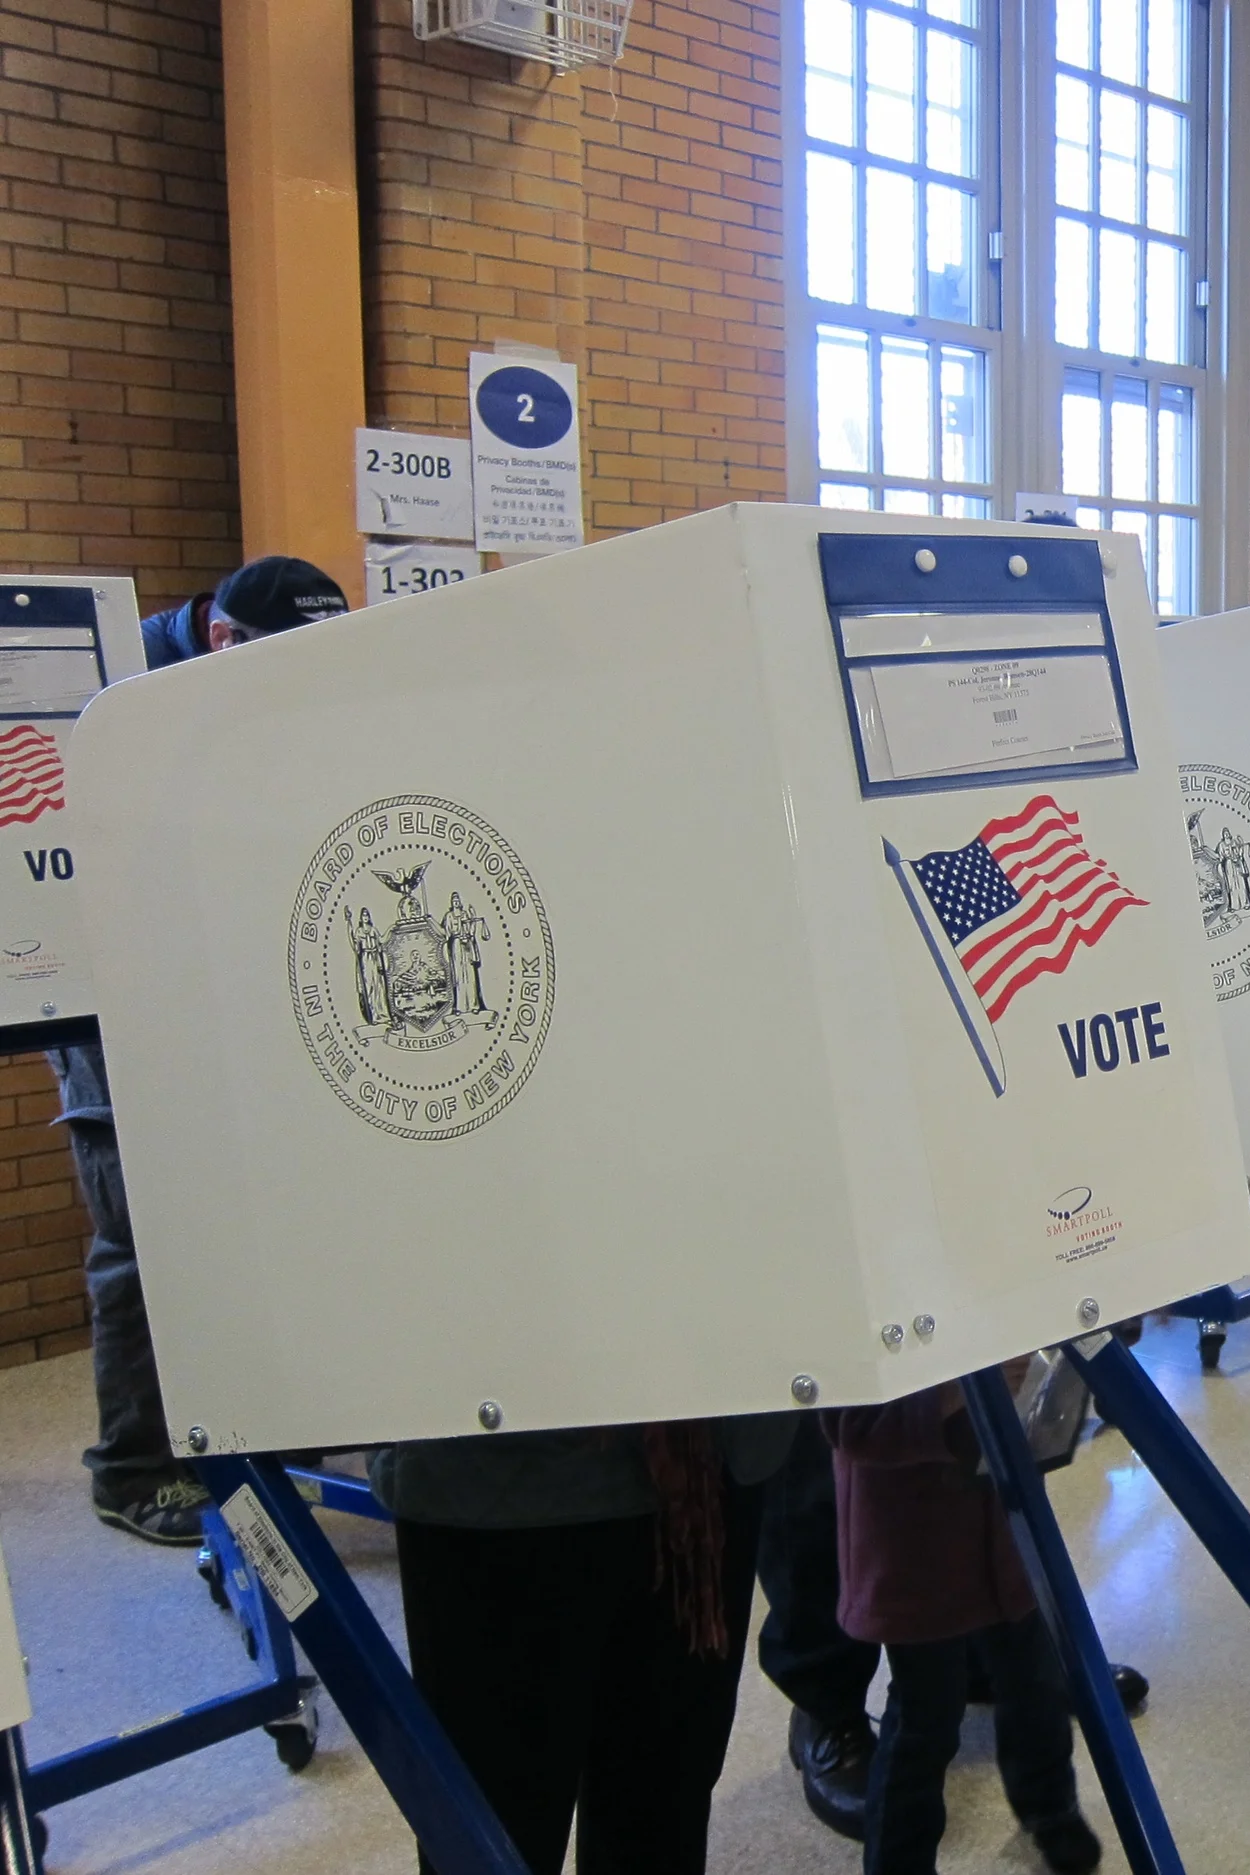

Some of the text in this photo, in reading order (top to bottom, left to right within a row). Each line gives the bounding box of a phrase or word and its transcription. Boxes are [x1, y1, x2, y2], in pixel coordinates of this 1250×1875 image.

[516, 394, 535, 423] 2
[367, 449, 451, 479] 2-300B
[477, 455, 508, 467] Privacy
[505, 475, 550, 486] Cabinas de
[390, 494, 440, 507] Mrs. Haase
[994, 663, 1011, 671] ZONE
[948, 680, 956, 688] PS
[1004, 692, 1013, 700] NY
[23, 847, 74, 881] VO
[301, 811, 527, 942] BOARD OF ELECTIONS
[1206, 922, 1232, 938] LSIOR
[1213, 968, 1236, 990] OF
[302, 955, 541, 1123] IN THE CITY OF NEW YORK
[398, 1030, 457, 1049] EXCELSIOR
[1057, 1001, 1171, 1079] VOTE
[1046, 1206, 1113, 1237] SMARTPOLL
[1076, 1222, 1122, 1242] VOTING BOOTH
[1055, 1253, 1069, 1261] TOLL
